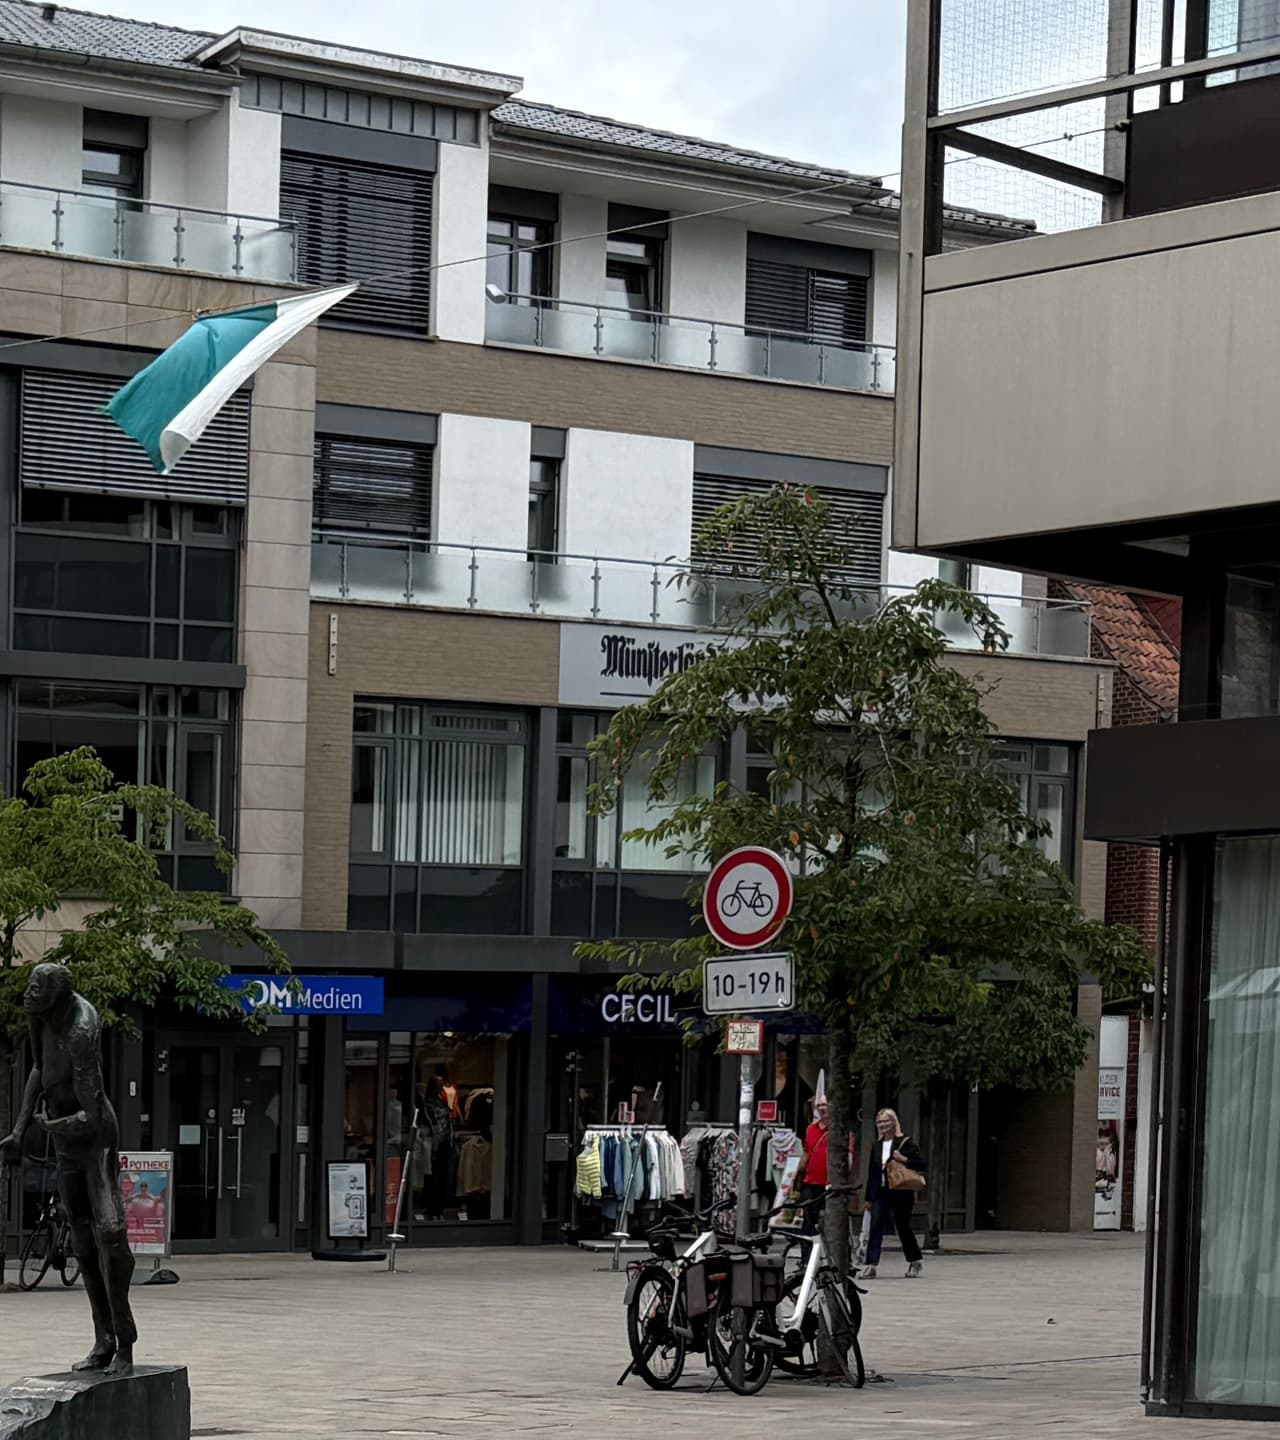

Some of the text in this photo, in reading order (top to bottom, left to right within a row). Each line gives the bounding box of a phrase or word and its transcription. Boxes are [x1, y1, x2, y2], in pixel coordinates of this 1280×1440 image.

[775, 971, 785, 993] h
[296, 987, 362, 1009] Medien
[601, 993, 676, 1023] CECIL
